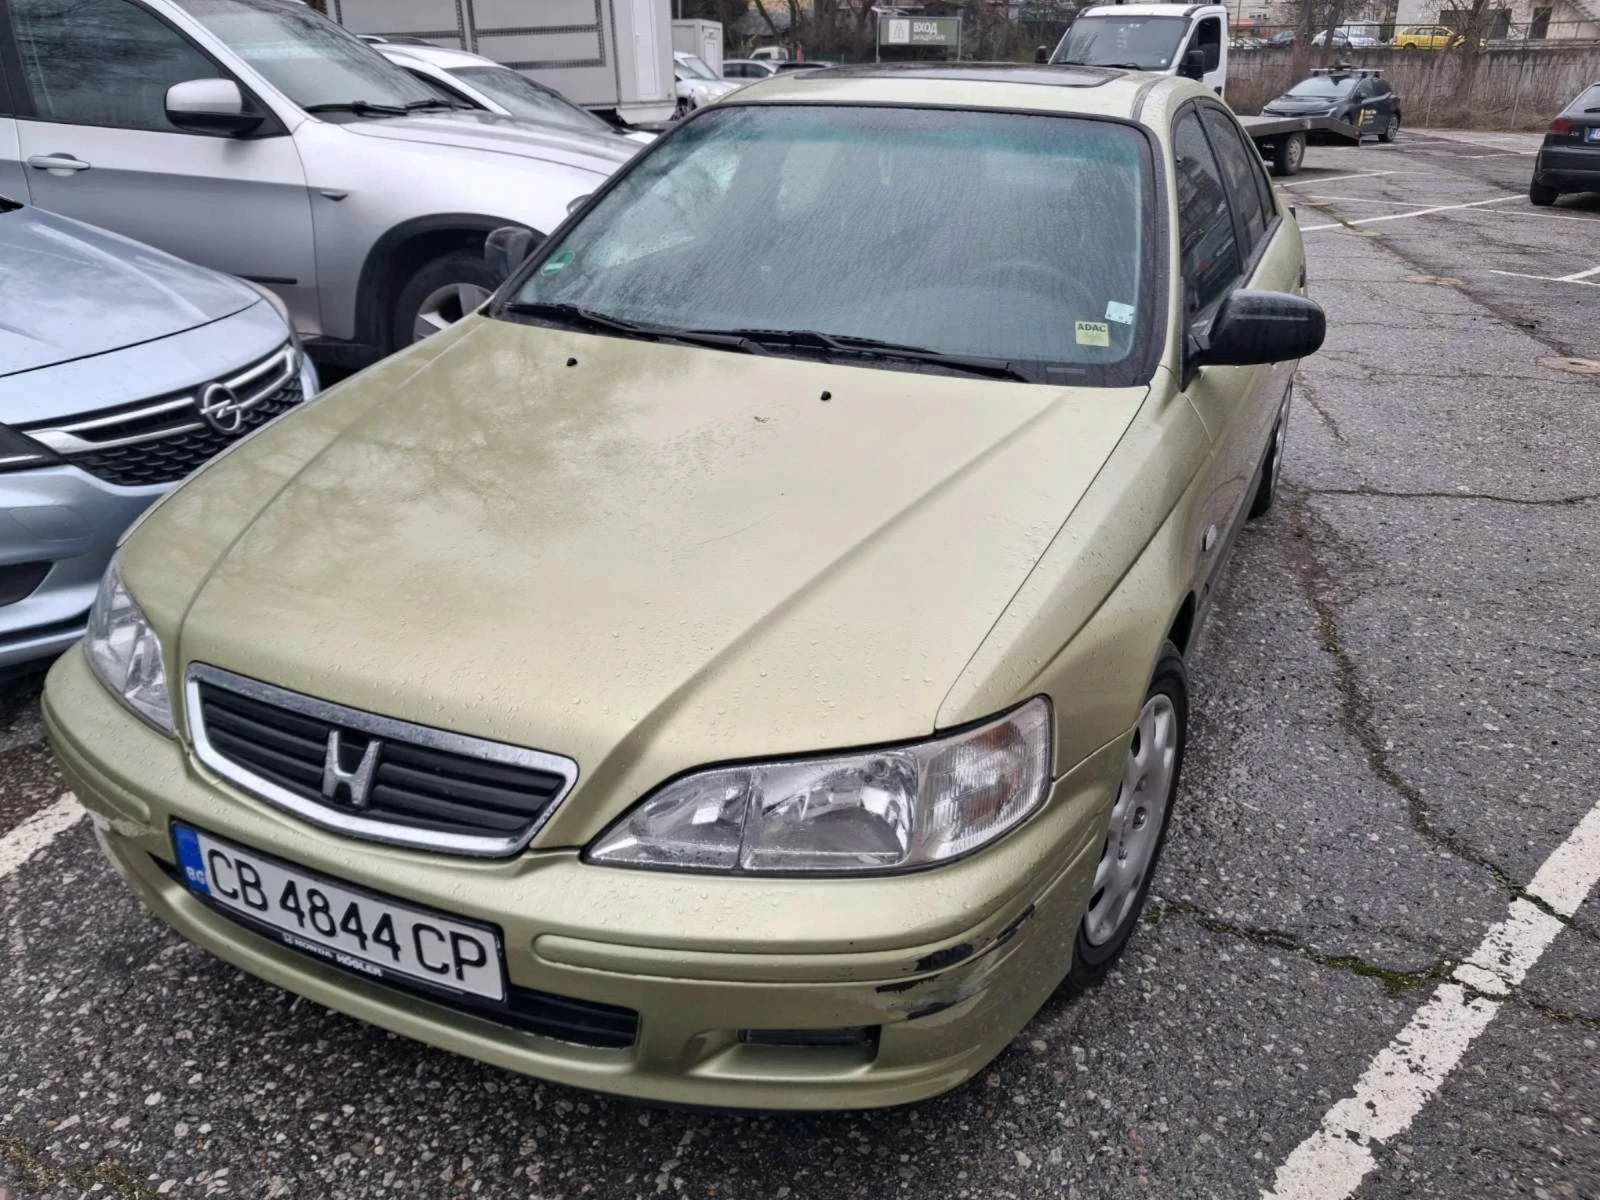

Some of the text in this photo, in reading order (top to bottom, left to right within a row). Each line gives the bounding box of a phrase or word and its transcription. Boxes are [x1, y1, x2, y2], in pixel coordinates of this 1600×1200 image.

[1077, 323, 1107, 332] ADAC
[185, 866, 206, 885] BG
[208, 849, 487, 981] CB 4844 CP
